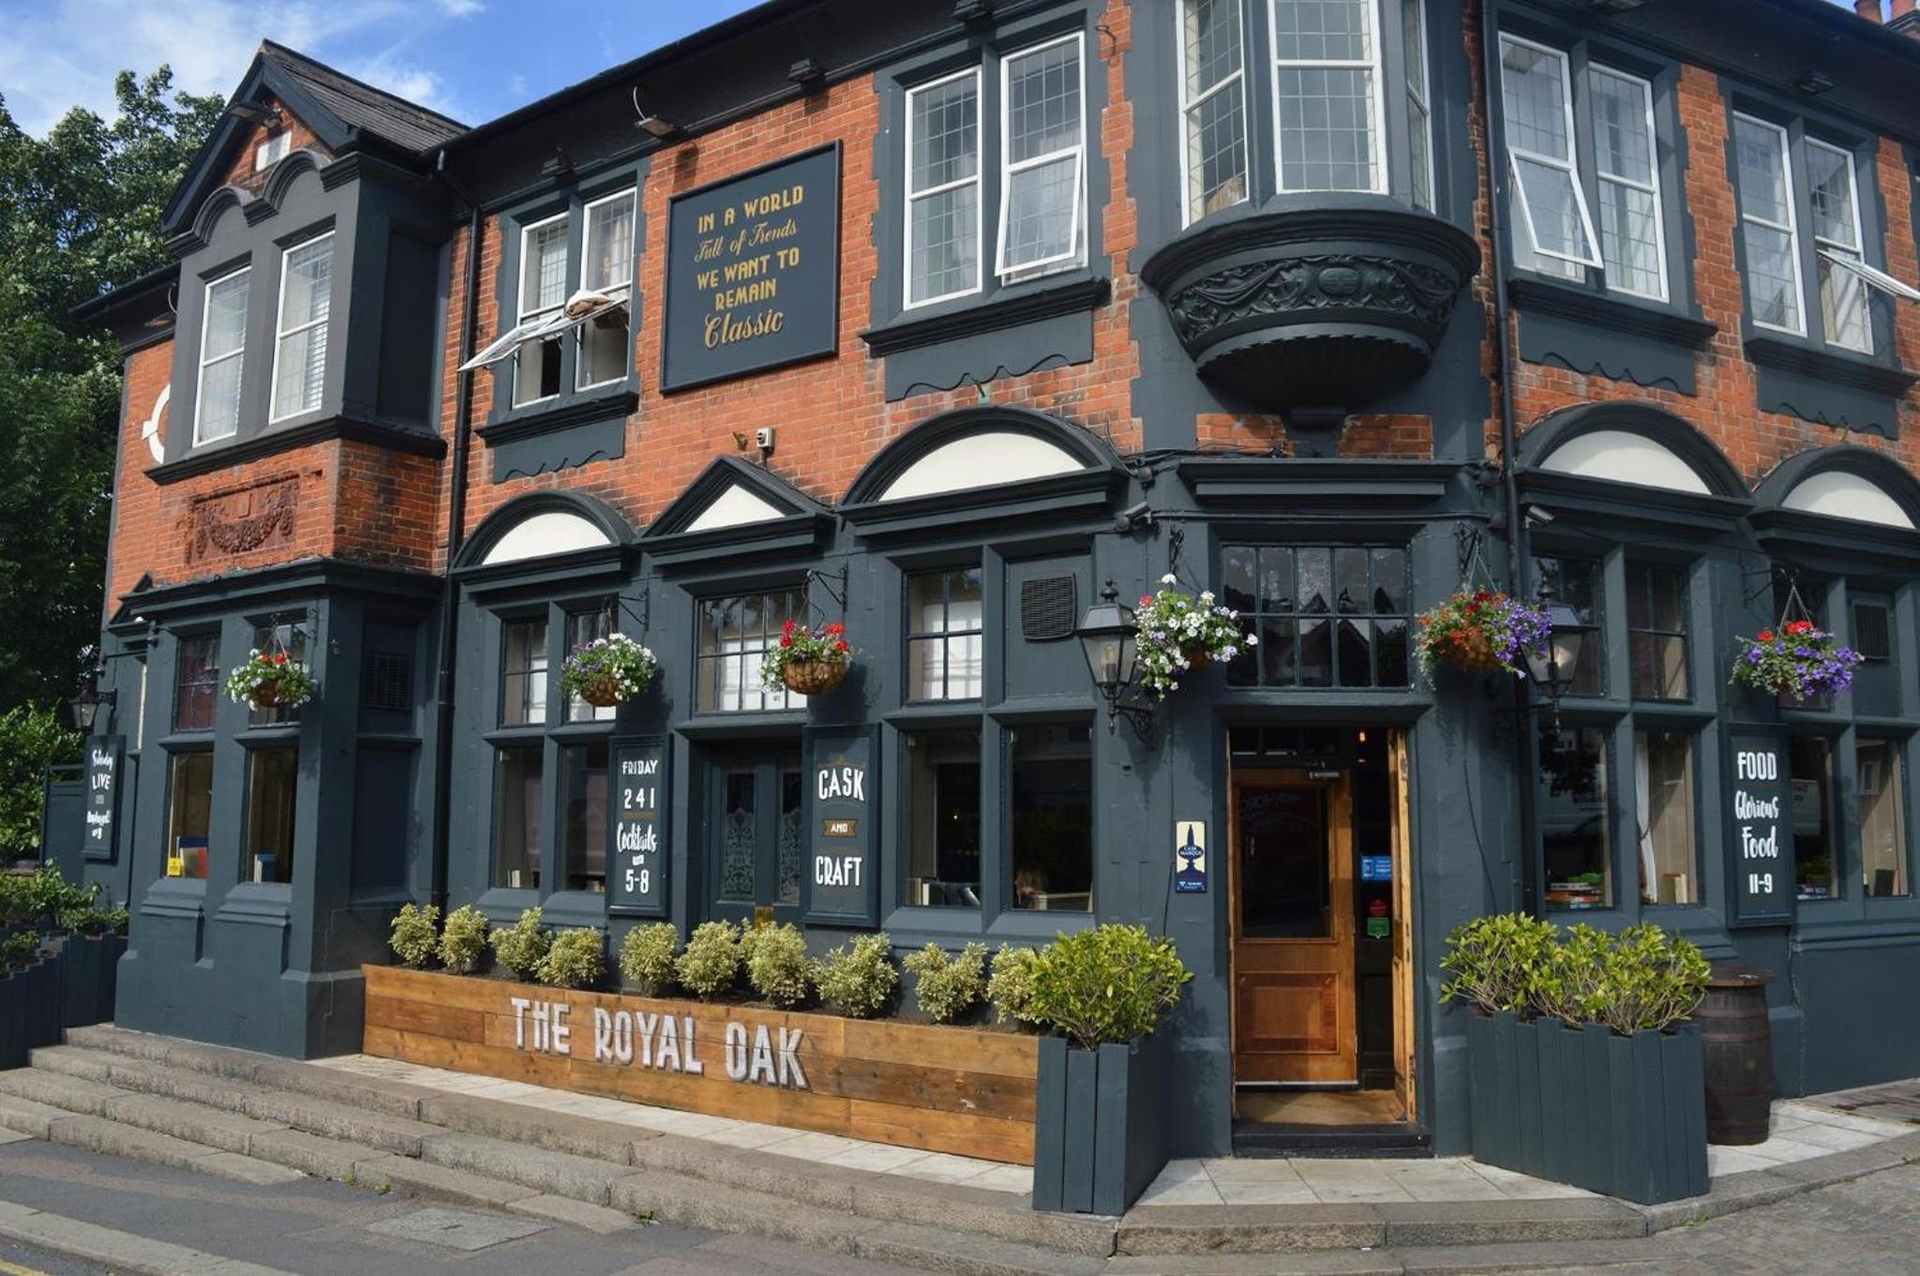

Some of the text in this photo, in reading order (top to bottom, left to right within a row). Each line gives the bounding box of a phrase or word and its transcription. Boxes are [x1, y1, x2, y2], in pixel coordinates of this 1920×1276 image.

[698, 185, 803, 233] IN A WORLD
[694, 218, 798, 262] Full of Trends
[697, 247, 799, 290] WE WANT TO
[715, 279, 776, 311] REMAIN
[704, 308, 784, 348] Classic
[622, 759, 658, 775] FRIDAY
[1737, 751, 1778, 780] FOOD
[92, 773, 111, 790] LIVE
[818, 767, 865, 801] CASK
[1734, 790, 1779, 820] Glorious
[617, 822, 657, 853] Cocktails
[1741, 825, 1779, 859] Food
[625, 869, 650, 894] 5-8
[816, 855, 862, 886] CRAFT
[1749, 873, 1773, 894] 11-9
[511, 997, 812, 1091] THE ROYAL OAK
